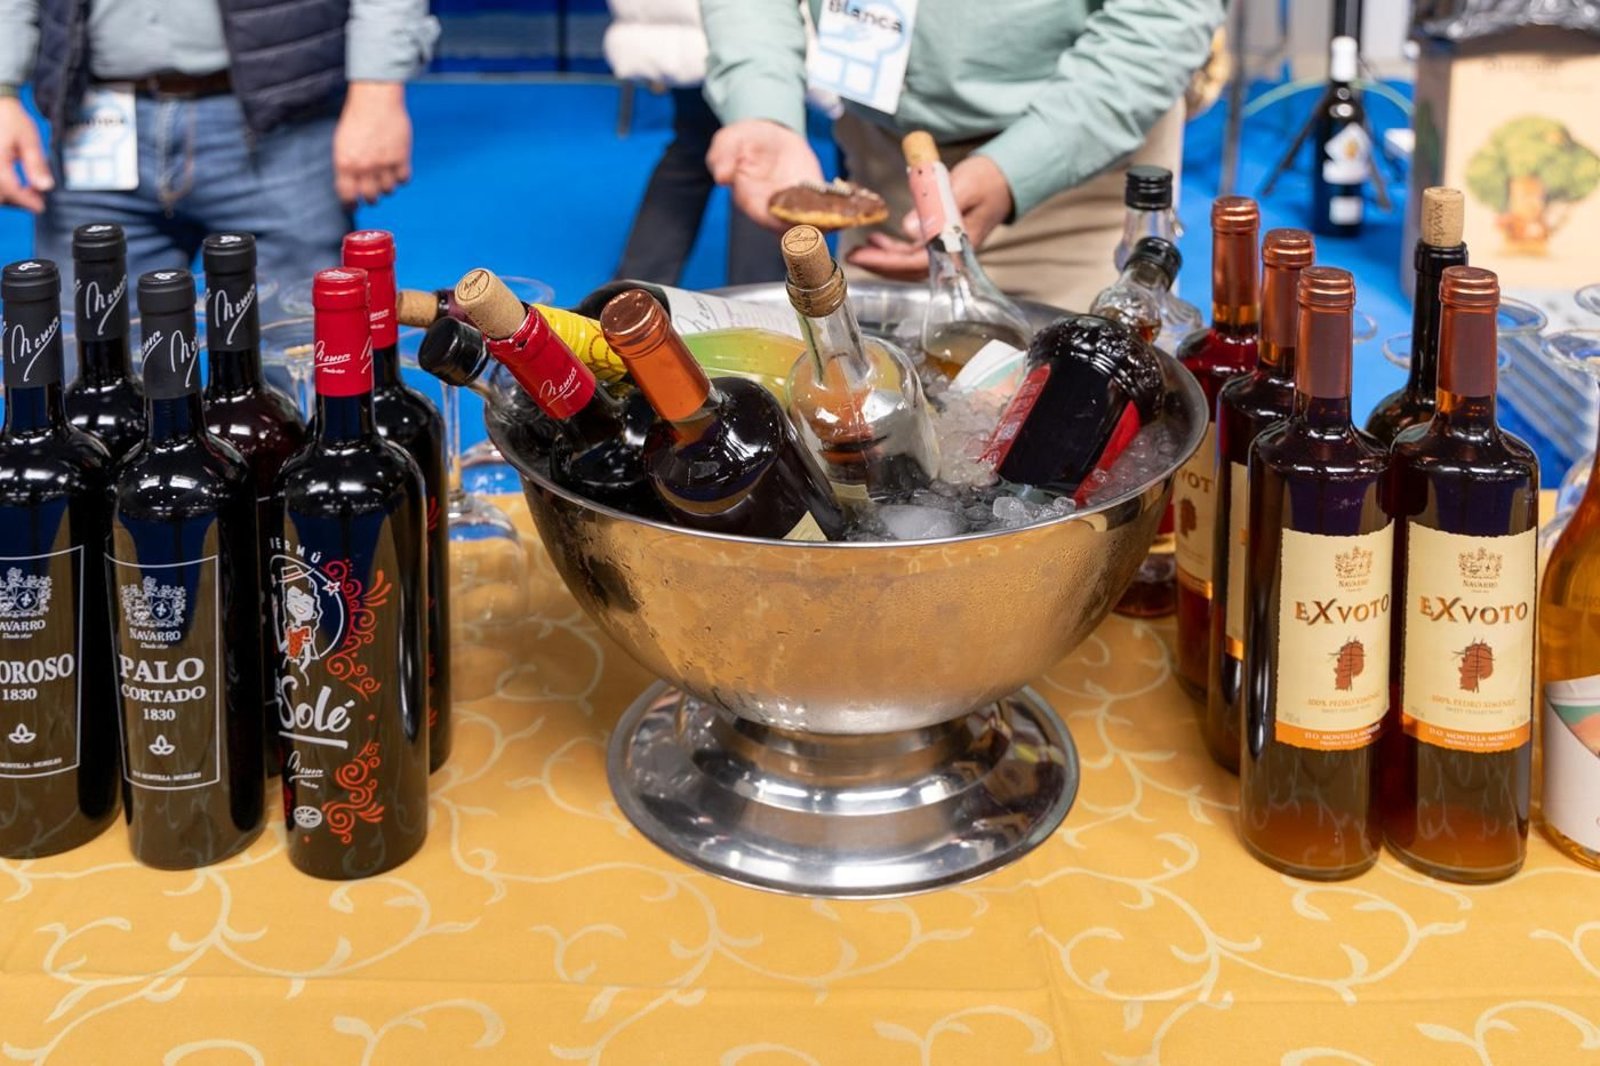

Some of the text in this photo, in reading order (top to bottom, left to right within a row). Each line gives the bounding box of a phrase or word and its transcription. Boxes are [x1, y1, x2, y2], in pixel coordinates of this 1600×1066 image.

[828, 0, 903, 33] Blanca
[129, 627, 181, 642] NAVARRO
[0, 653, 74, 684] OROSO
[119, 654, 205, 683] PALO
[2, 687, 38, 700] 1830
[121, 684, 206, 703] CORTADO
[277, 675, 355, 733] Solé
[143, 708, 176, 721] 1830
